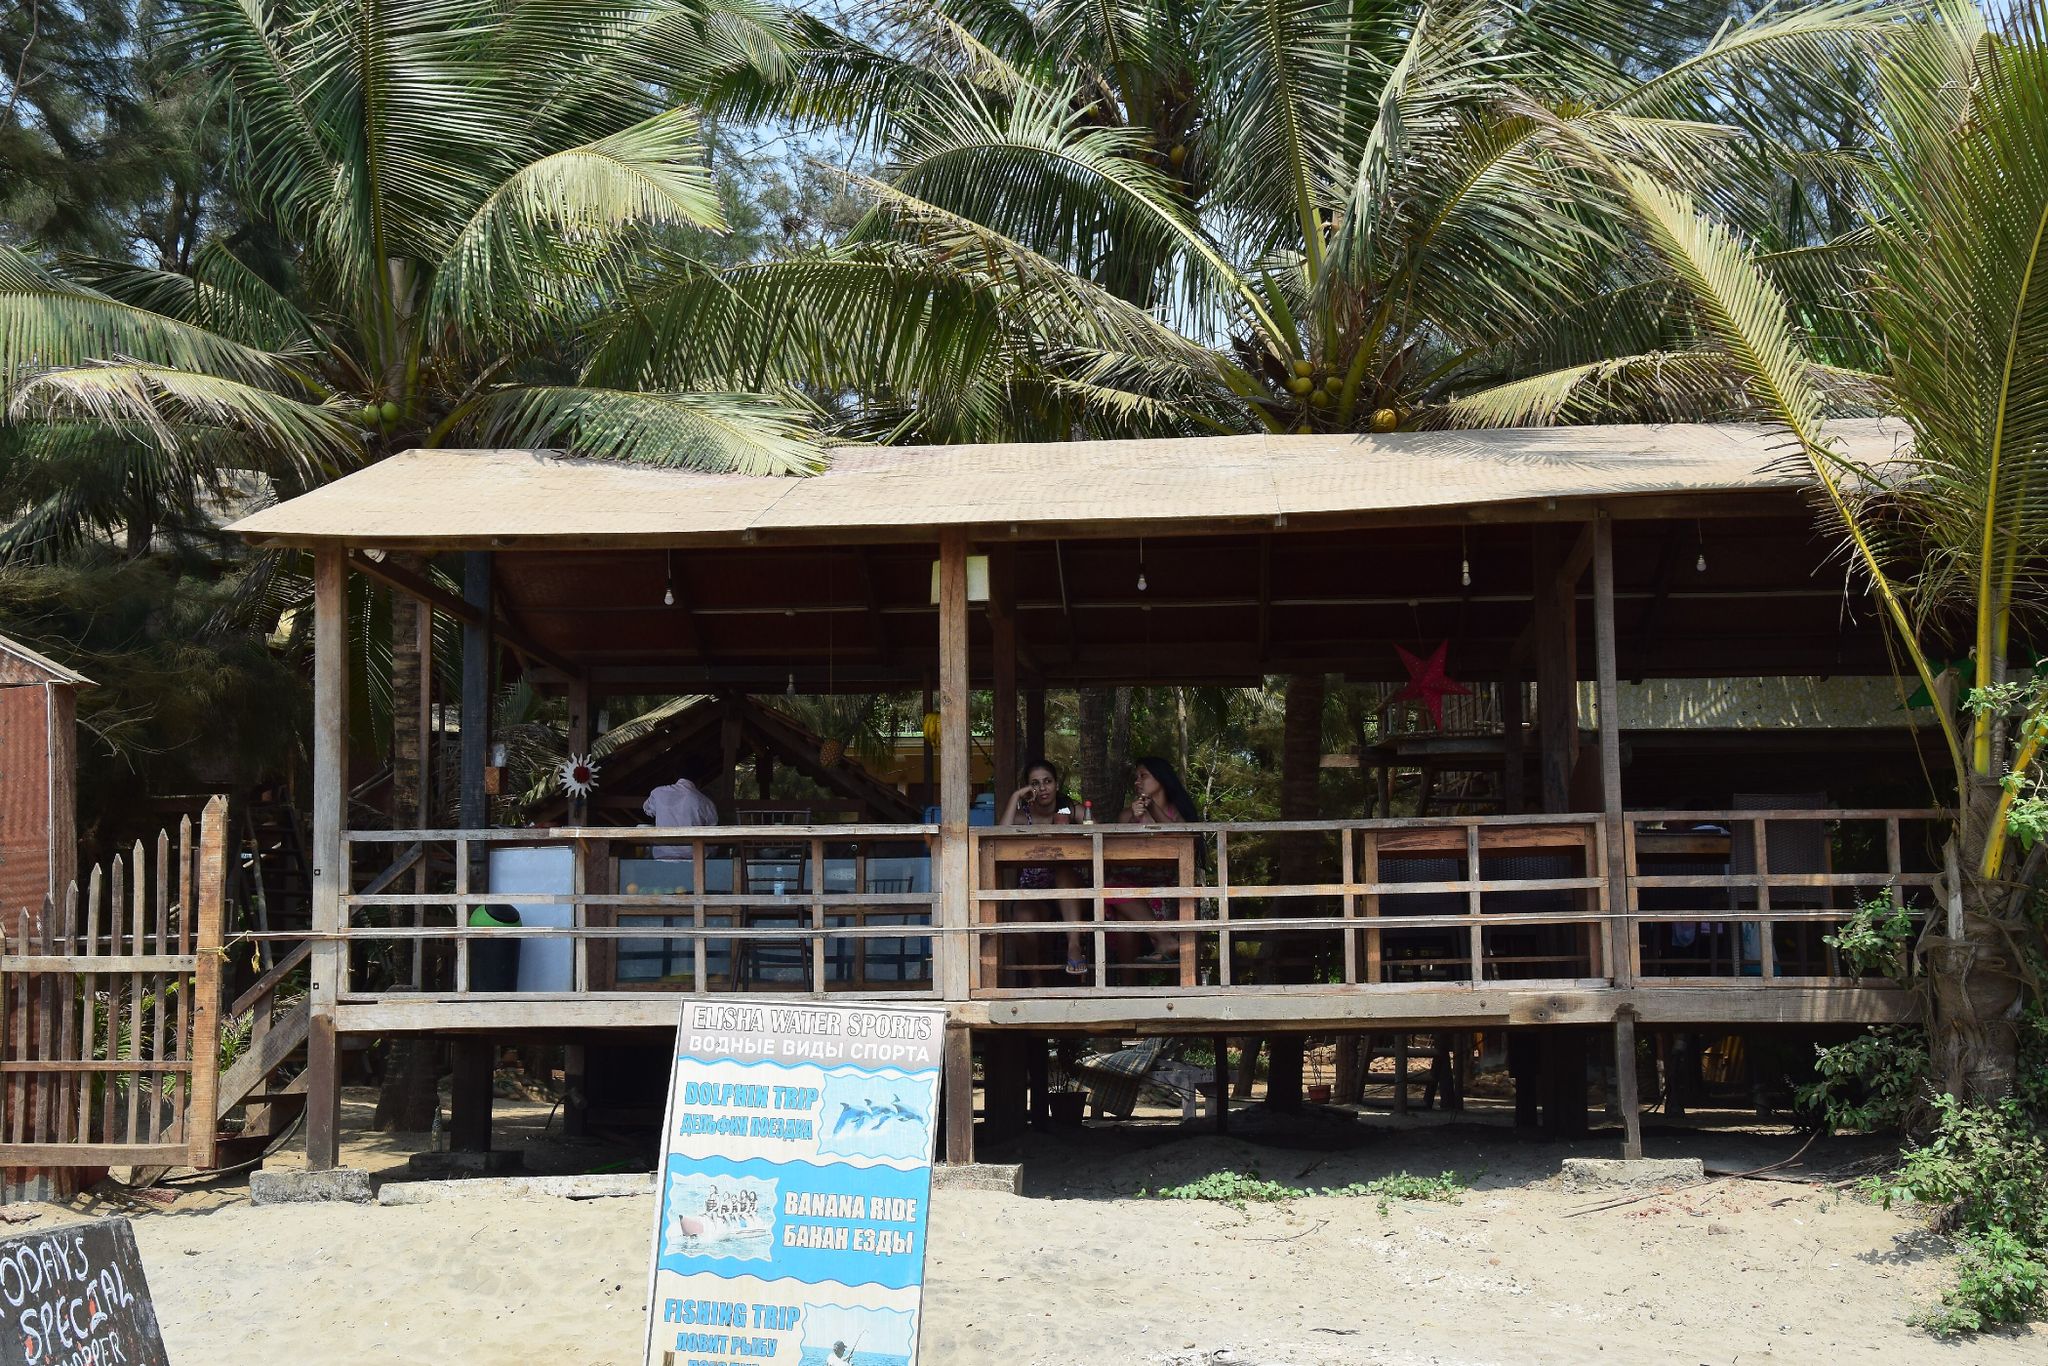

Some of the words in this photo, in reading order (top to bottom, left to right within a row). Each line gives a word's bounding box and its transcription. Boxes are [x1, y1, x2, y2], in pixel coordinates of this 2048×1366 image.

[693, 1006, 764, 1032] ELISHA
[771, 1010, 841, 1035] WATER
[847, 1012, 932, 1040] SPORTS
[689, 1035, 775, 1054] ВОДНЫЕ
[782, 1039, 844, 1059] ВИДЫ
[850, 1043, 930, 1062] СПОРТА
[685, 1082, 769, 1109] DOLPHIN
[773, 1086, 819, 1111] TRIP
[784, 1192, 865, 1219] BANANA
[870, 1197, 917, 1223] RIDE
[783, 1224, 849, 1250] БАНАН
[853, 1228, 914, 1257] ЕЗДЫ
[0, 1234, 89, 1308] ODAYS
[20, 1261, 134, 1366] SPECIAL
[664, 1298, 747, 1328] FISHING
[752, 1304, 801, 1331] TRIP
[675, 1332, 729, 1354] ЛОВИТ
